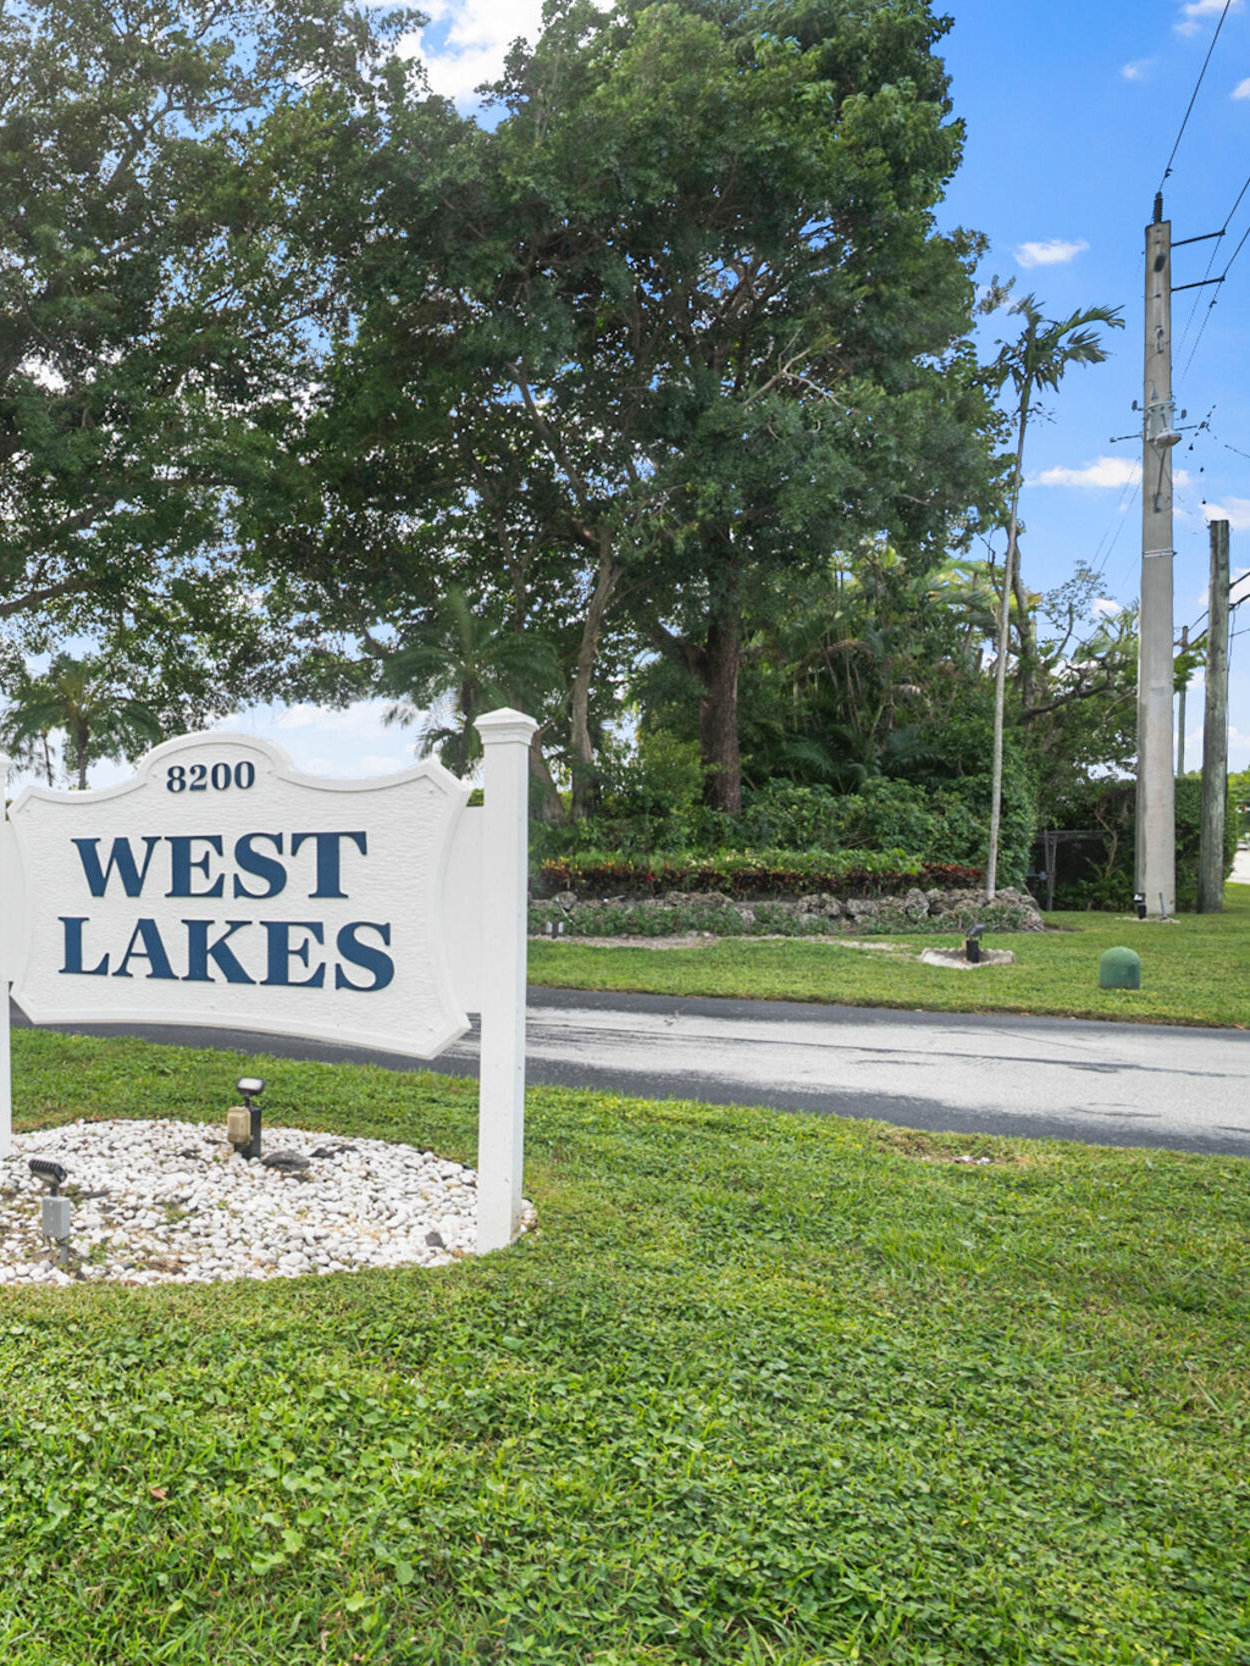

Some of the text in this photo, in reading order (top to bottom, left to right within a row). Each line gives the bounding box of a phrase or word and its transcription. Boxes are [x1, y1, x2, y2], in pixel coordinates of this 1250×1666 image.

[166, 760, 256, 793] 8200
[70, 830, 368, 900] WEST
[57, 915, 396, 993] LAKES
